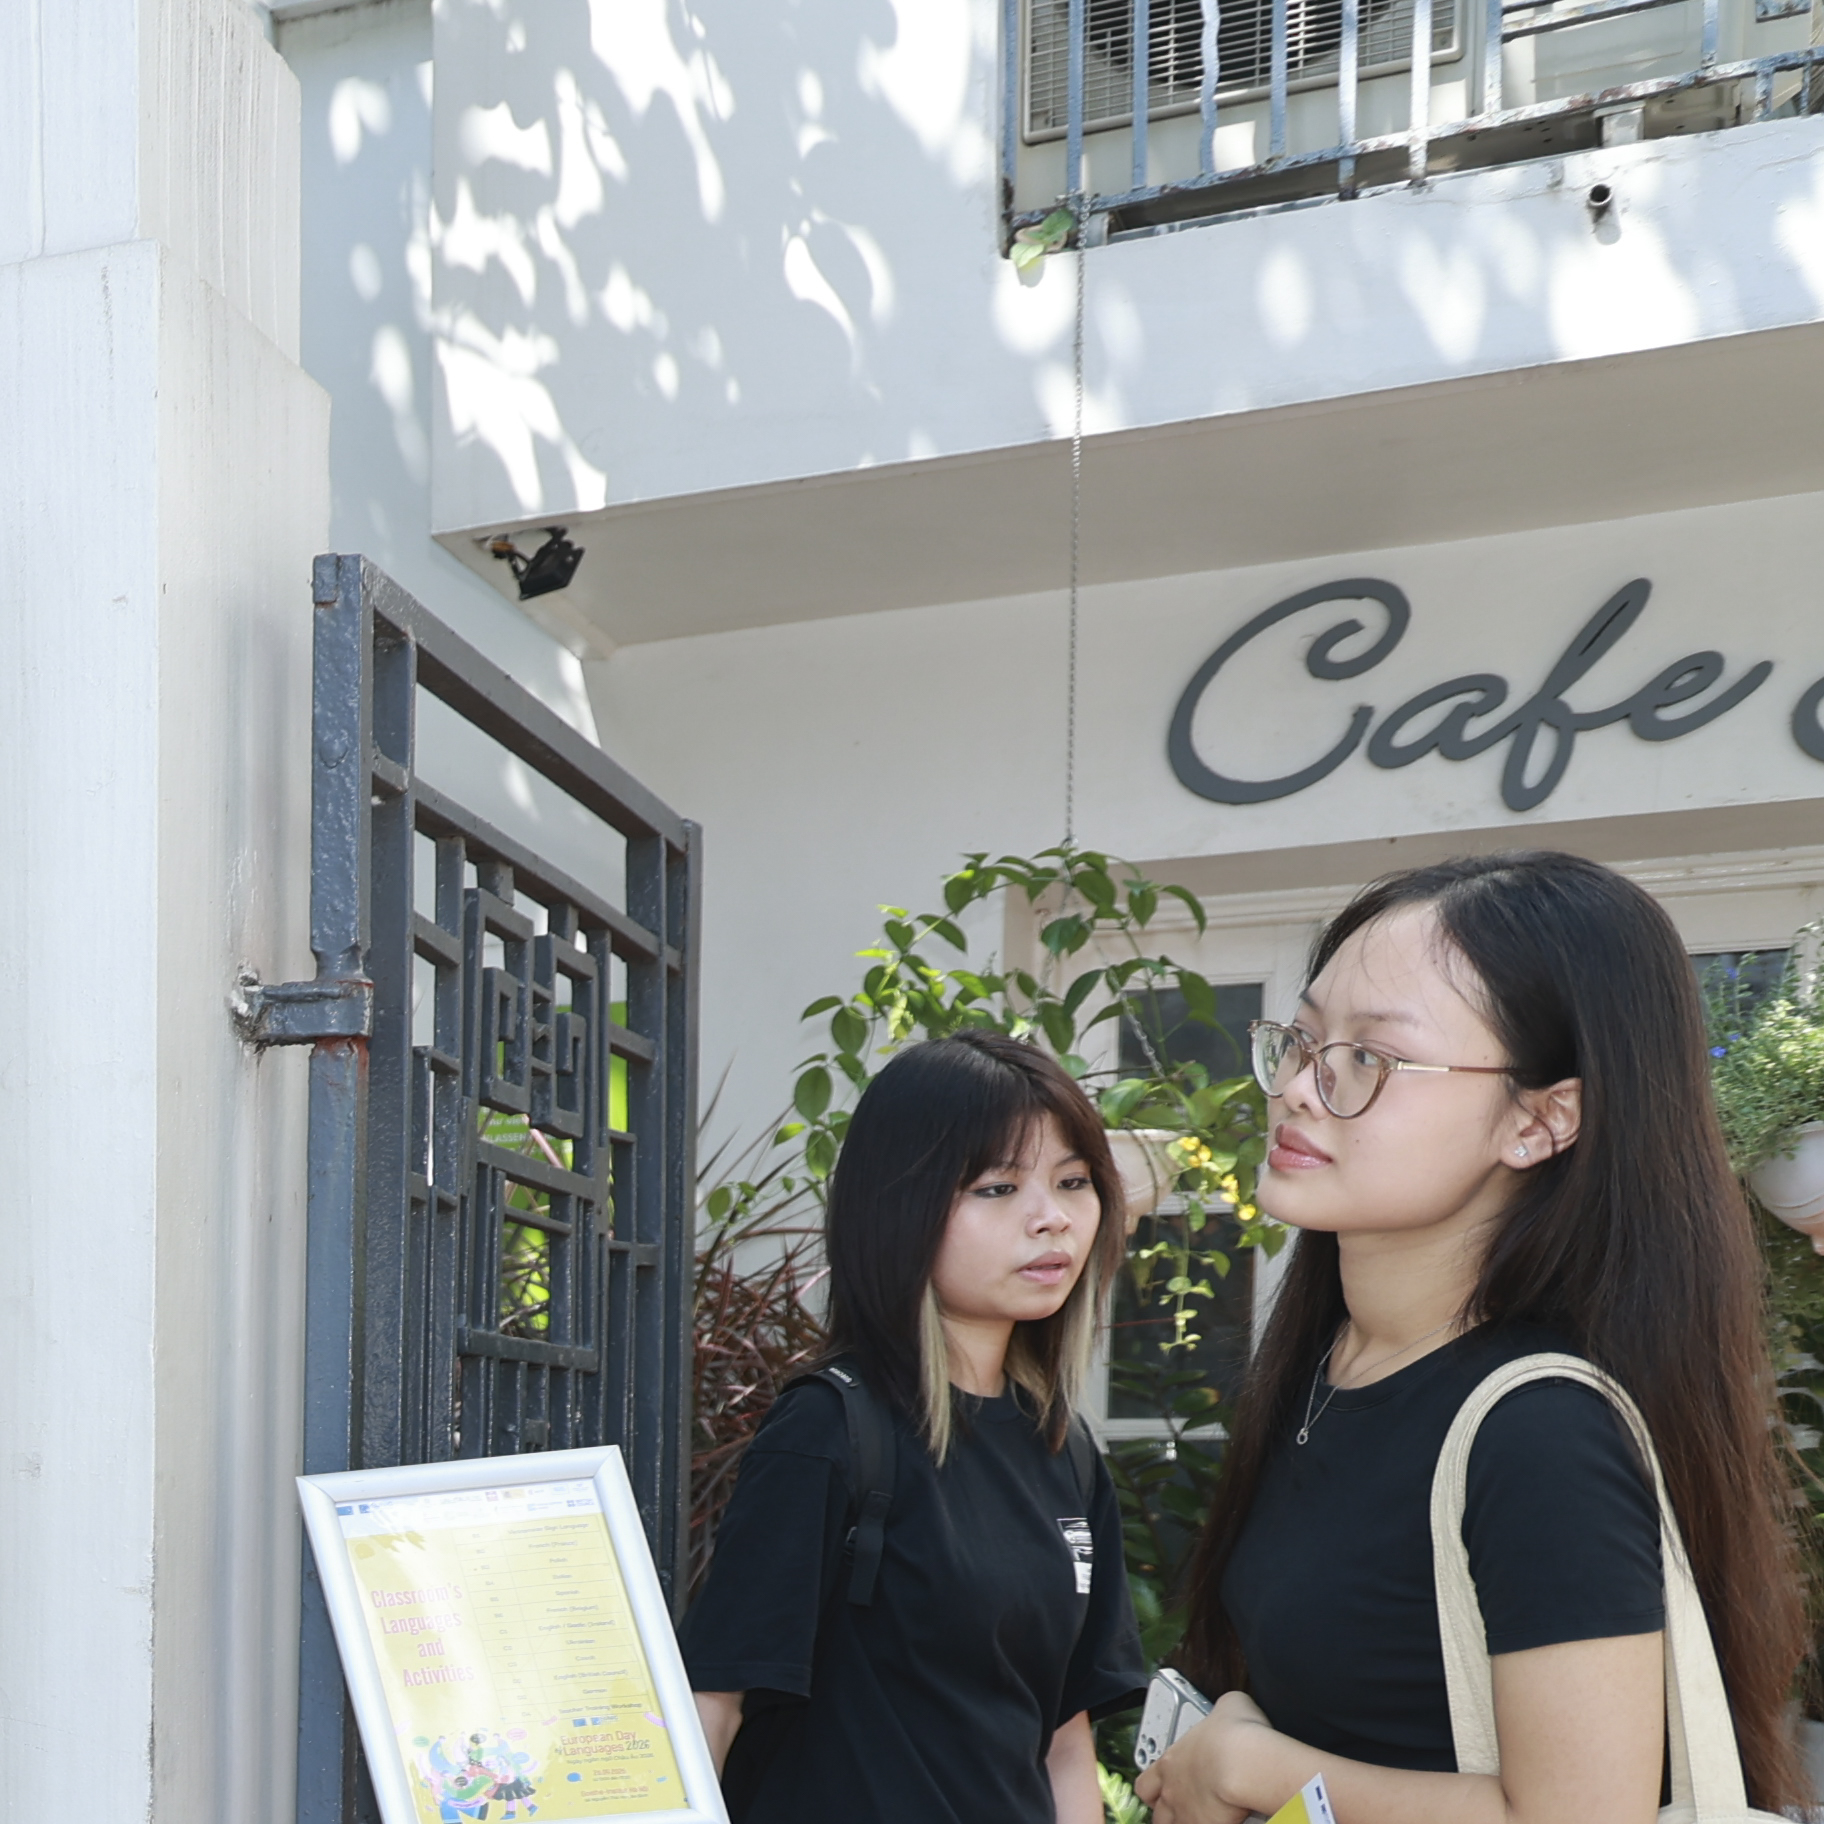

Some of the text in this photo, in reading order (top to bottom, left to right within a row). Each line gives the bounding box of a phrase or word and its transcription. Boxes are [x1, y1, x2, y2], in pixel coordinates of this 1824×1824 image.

[1167, 576, 1774, 812] Cafe
[371, 1581, 463, 1609] Classroom's
[380, 1612, 463, 1636] Languages
[417, 1637, 446, 1658] and
[402, 1663, 475, 1688] Activities
[560, 1730, 637, 1746] European Day
[563, 1743, 625, 1757] Languages
